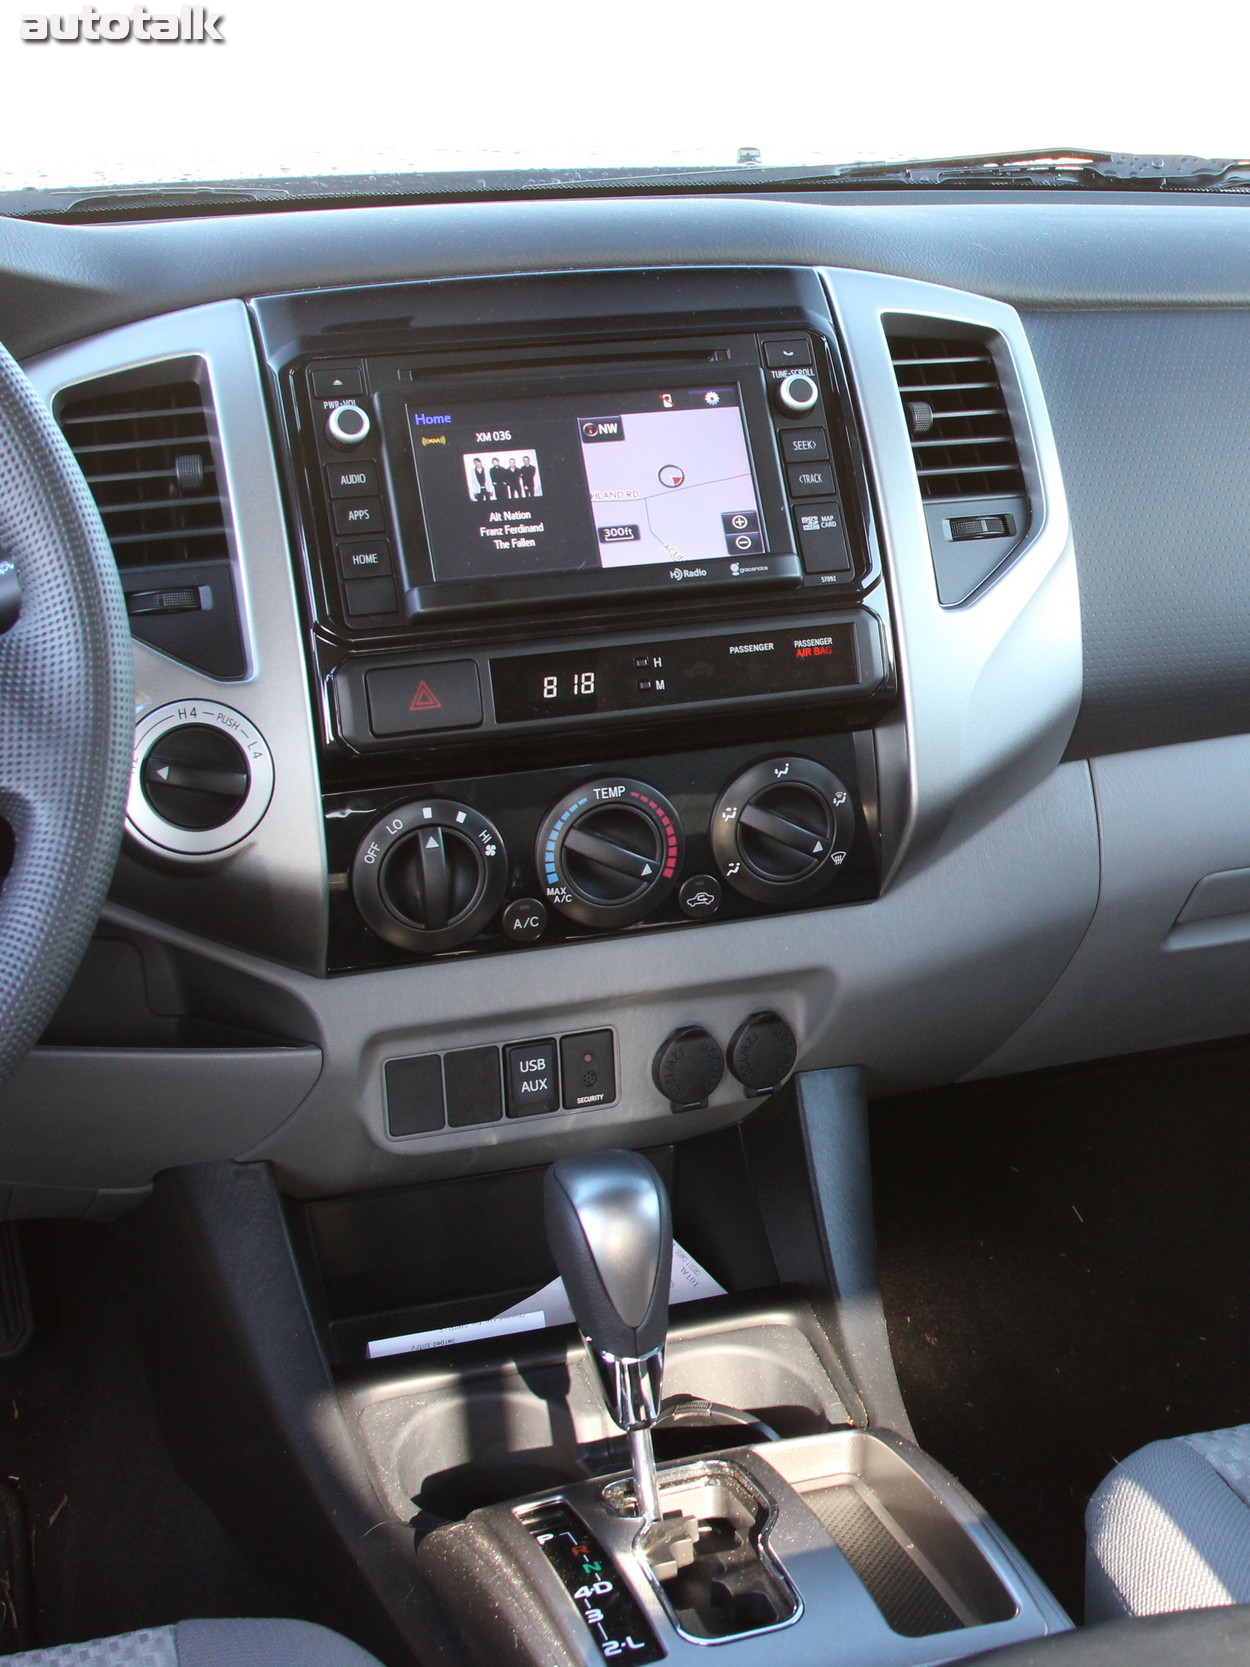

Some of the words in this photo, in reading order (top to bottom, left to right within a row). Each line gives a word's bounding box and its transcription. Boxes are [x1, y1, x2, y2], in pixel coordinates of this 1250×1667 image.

[414, 413, 452, 425] Home
[598, 423, 617, 434] NW
[476, 431, 491, 442] XM
[492, 430, 512, 441] 036
[341, 473, 366, 485] AUDIO
[627, 490, 640, 498] RD
[348, 509, 370, 521] APPS
[489, 512, 502, 522] Alt
[503, 510, 531, 521] Nation
[480, 526, 504, 537] Franz
[504, 522, 544, 535] Ferdinand
[821, 521, 837, 529] CARD
[604, 527, 632, 537] 300ft
[493, 539, 510, 549] The
[511, 537, 536, 548] Fallen
[352, 553, 378, 565] HOME
[684, 568, 707, 578] Radio
[739, 565, 769, 574] gracenote
[729, 642, 775, 654] PASSENGER
[794, 637, 833, 648] PASSENGER
[796, 647, 812, 658] AIR
[813, 646, 833, 656] BAG
[653, 657, 662, 668] H
[543, 676, 558, 698] 8
[573, 672, 595, 695] 18
[655, 679, 665, 690] M
[217, 713, 240, 731] PUSH
[593, 785, 626, 800] TEMP
[386, 818, 404, 835] LO
[478, 829, 493, 844] HI
[364, 841, 381, 864] OFF
[547, 886, 567, 896] MAX
[553, 894, 573, 903] A/C
[513, 916, 539, 930] A/C
[520, 1058, 546, 1073] USB
[521, 1078, 548, 1093] AUX
[577, 1093, 604, 1104] SECURITY
[536, 1533, 554, 1545] P
[571, 1545, 589, 1556] R
[582, 1561, 602, 1574] N
[585, 1609, 604, 1624] 3
